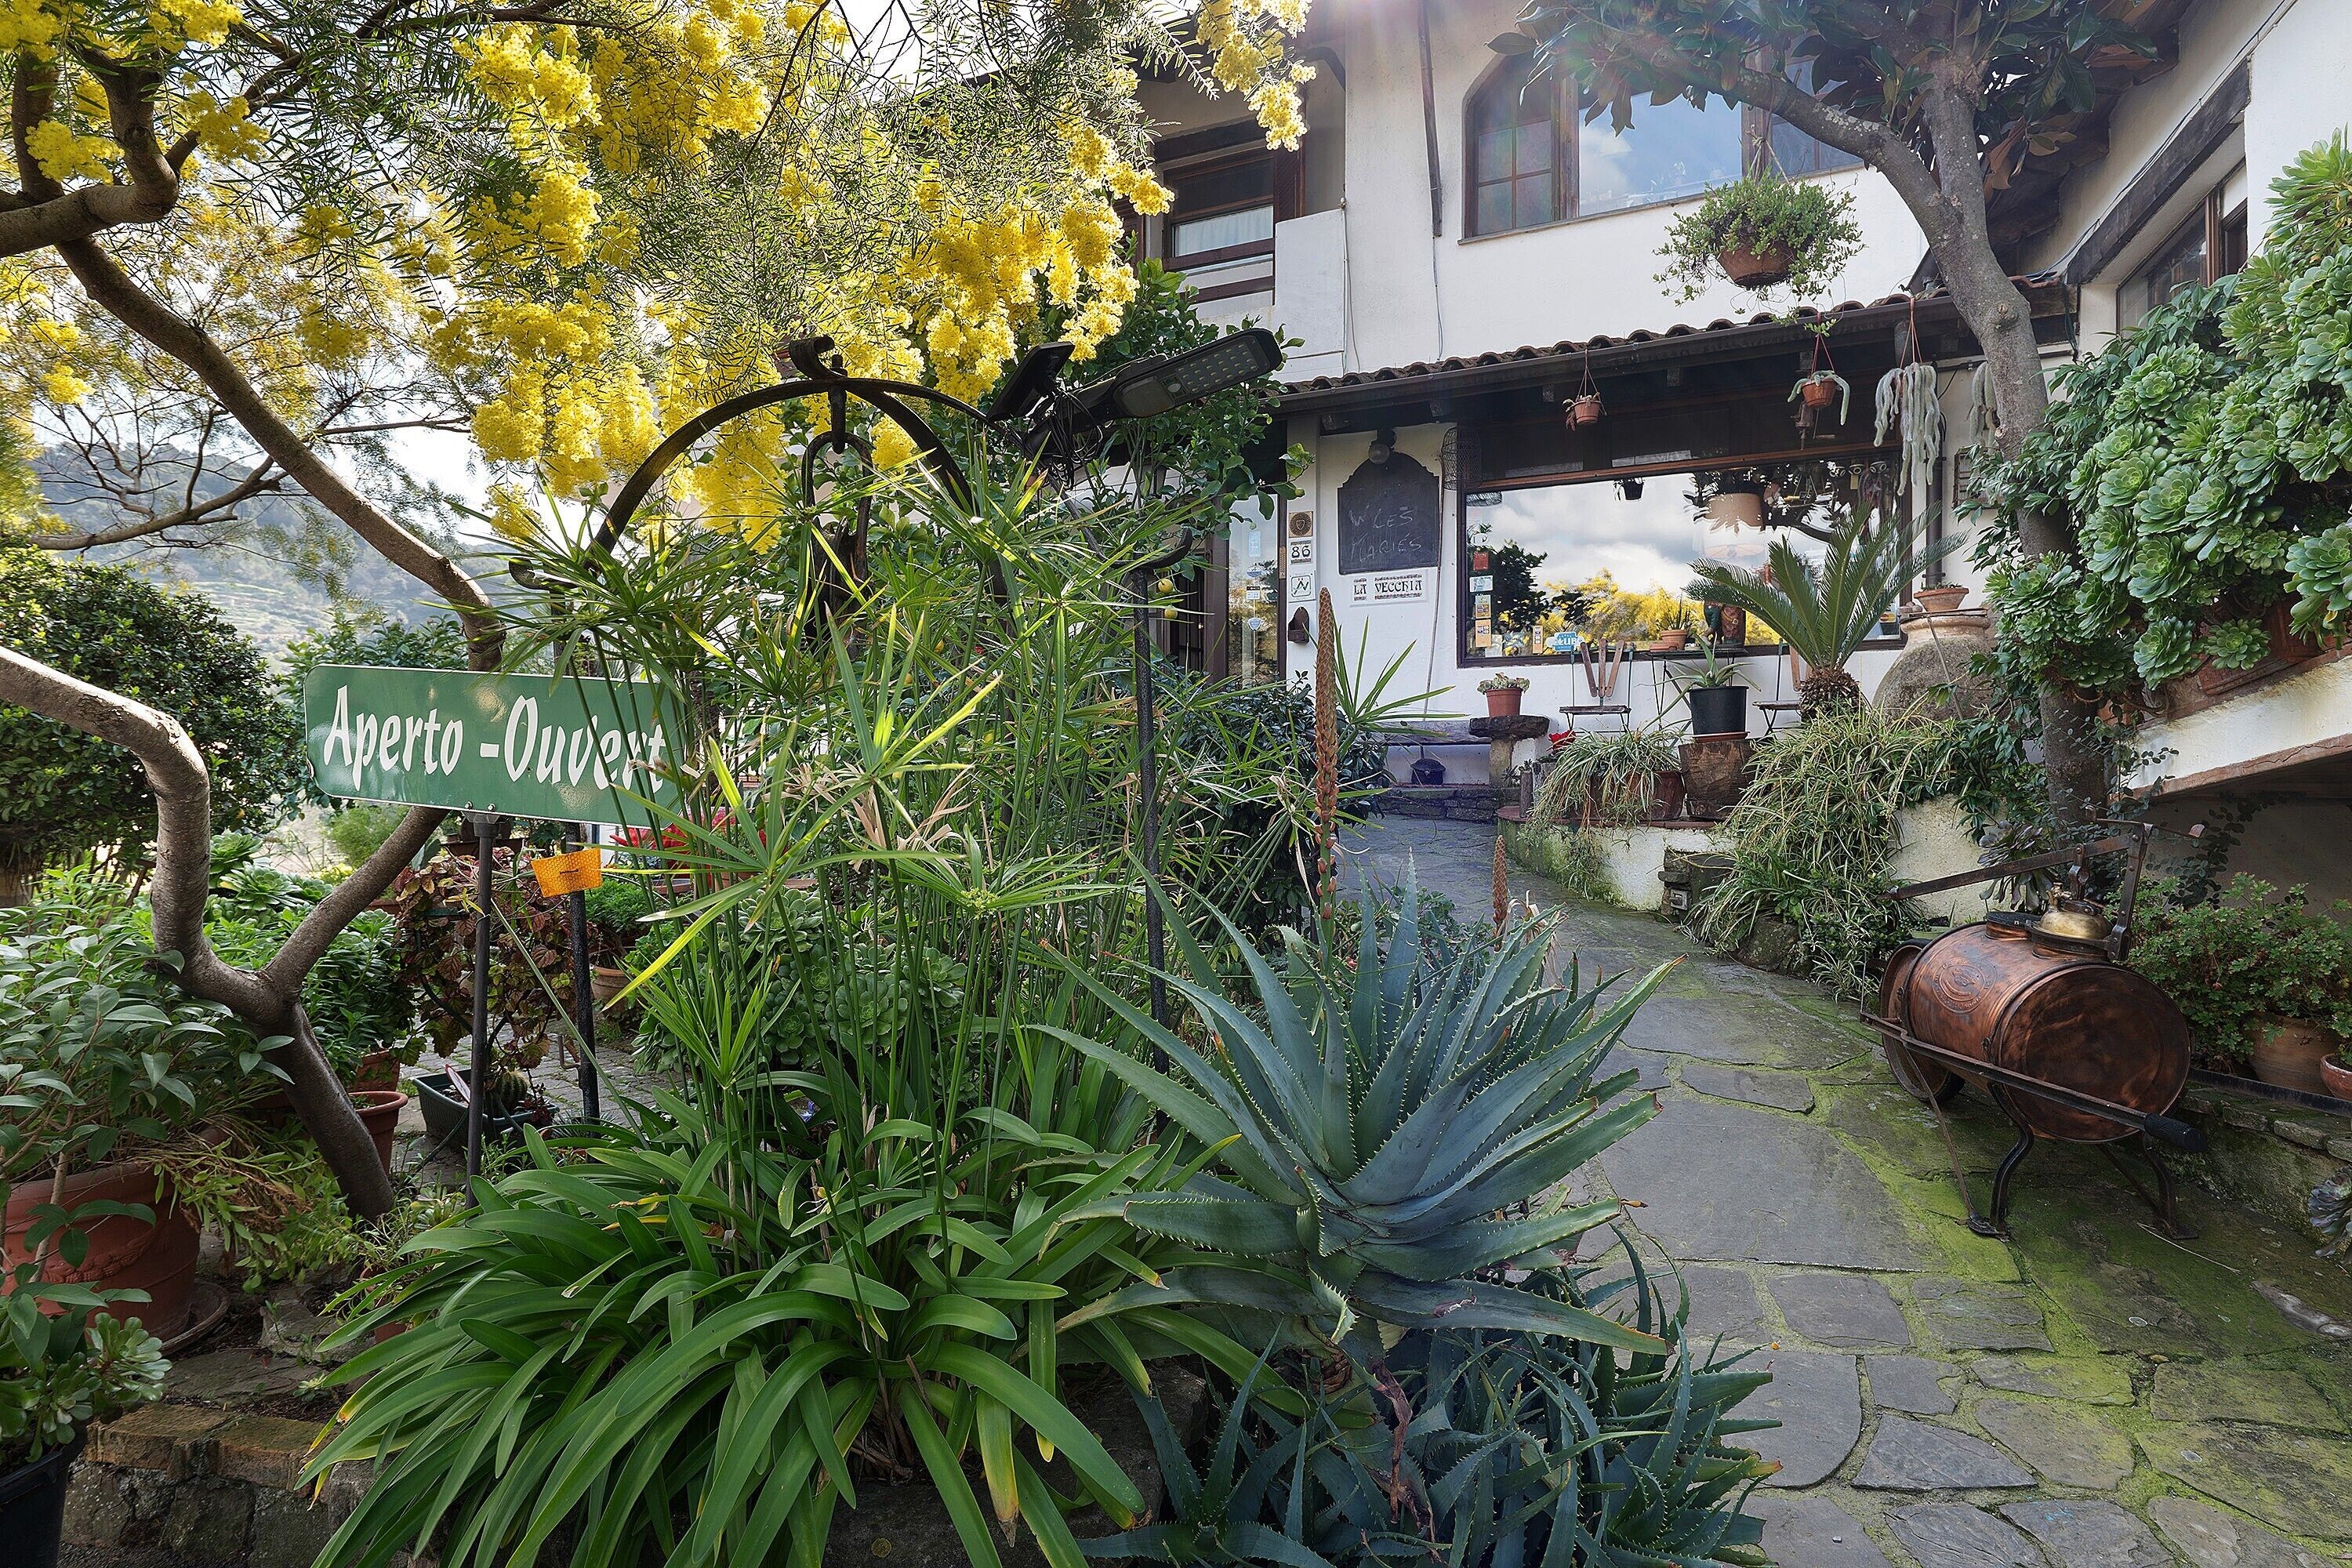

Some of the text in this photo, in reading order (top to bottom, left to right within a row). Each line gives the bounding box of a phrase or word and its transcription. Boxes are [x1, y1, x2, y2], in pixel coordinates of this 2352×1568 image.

[1373, 508, 1414, 528] LES
[1291, 545, 1311, 559] 86
[1353, 579, 1422, 595] LA VECCHIA
[323, 684, 463, 791] Aperto
